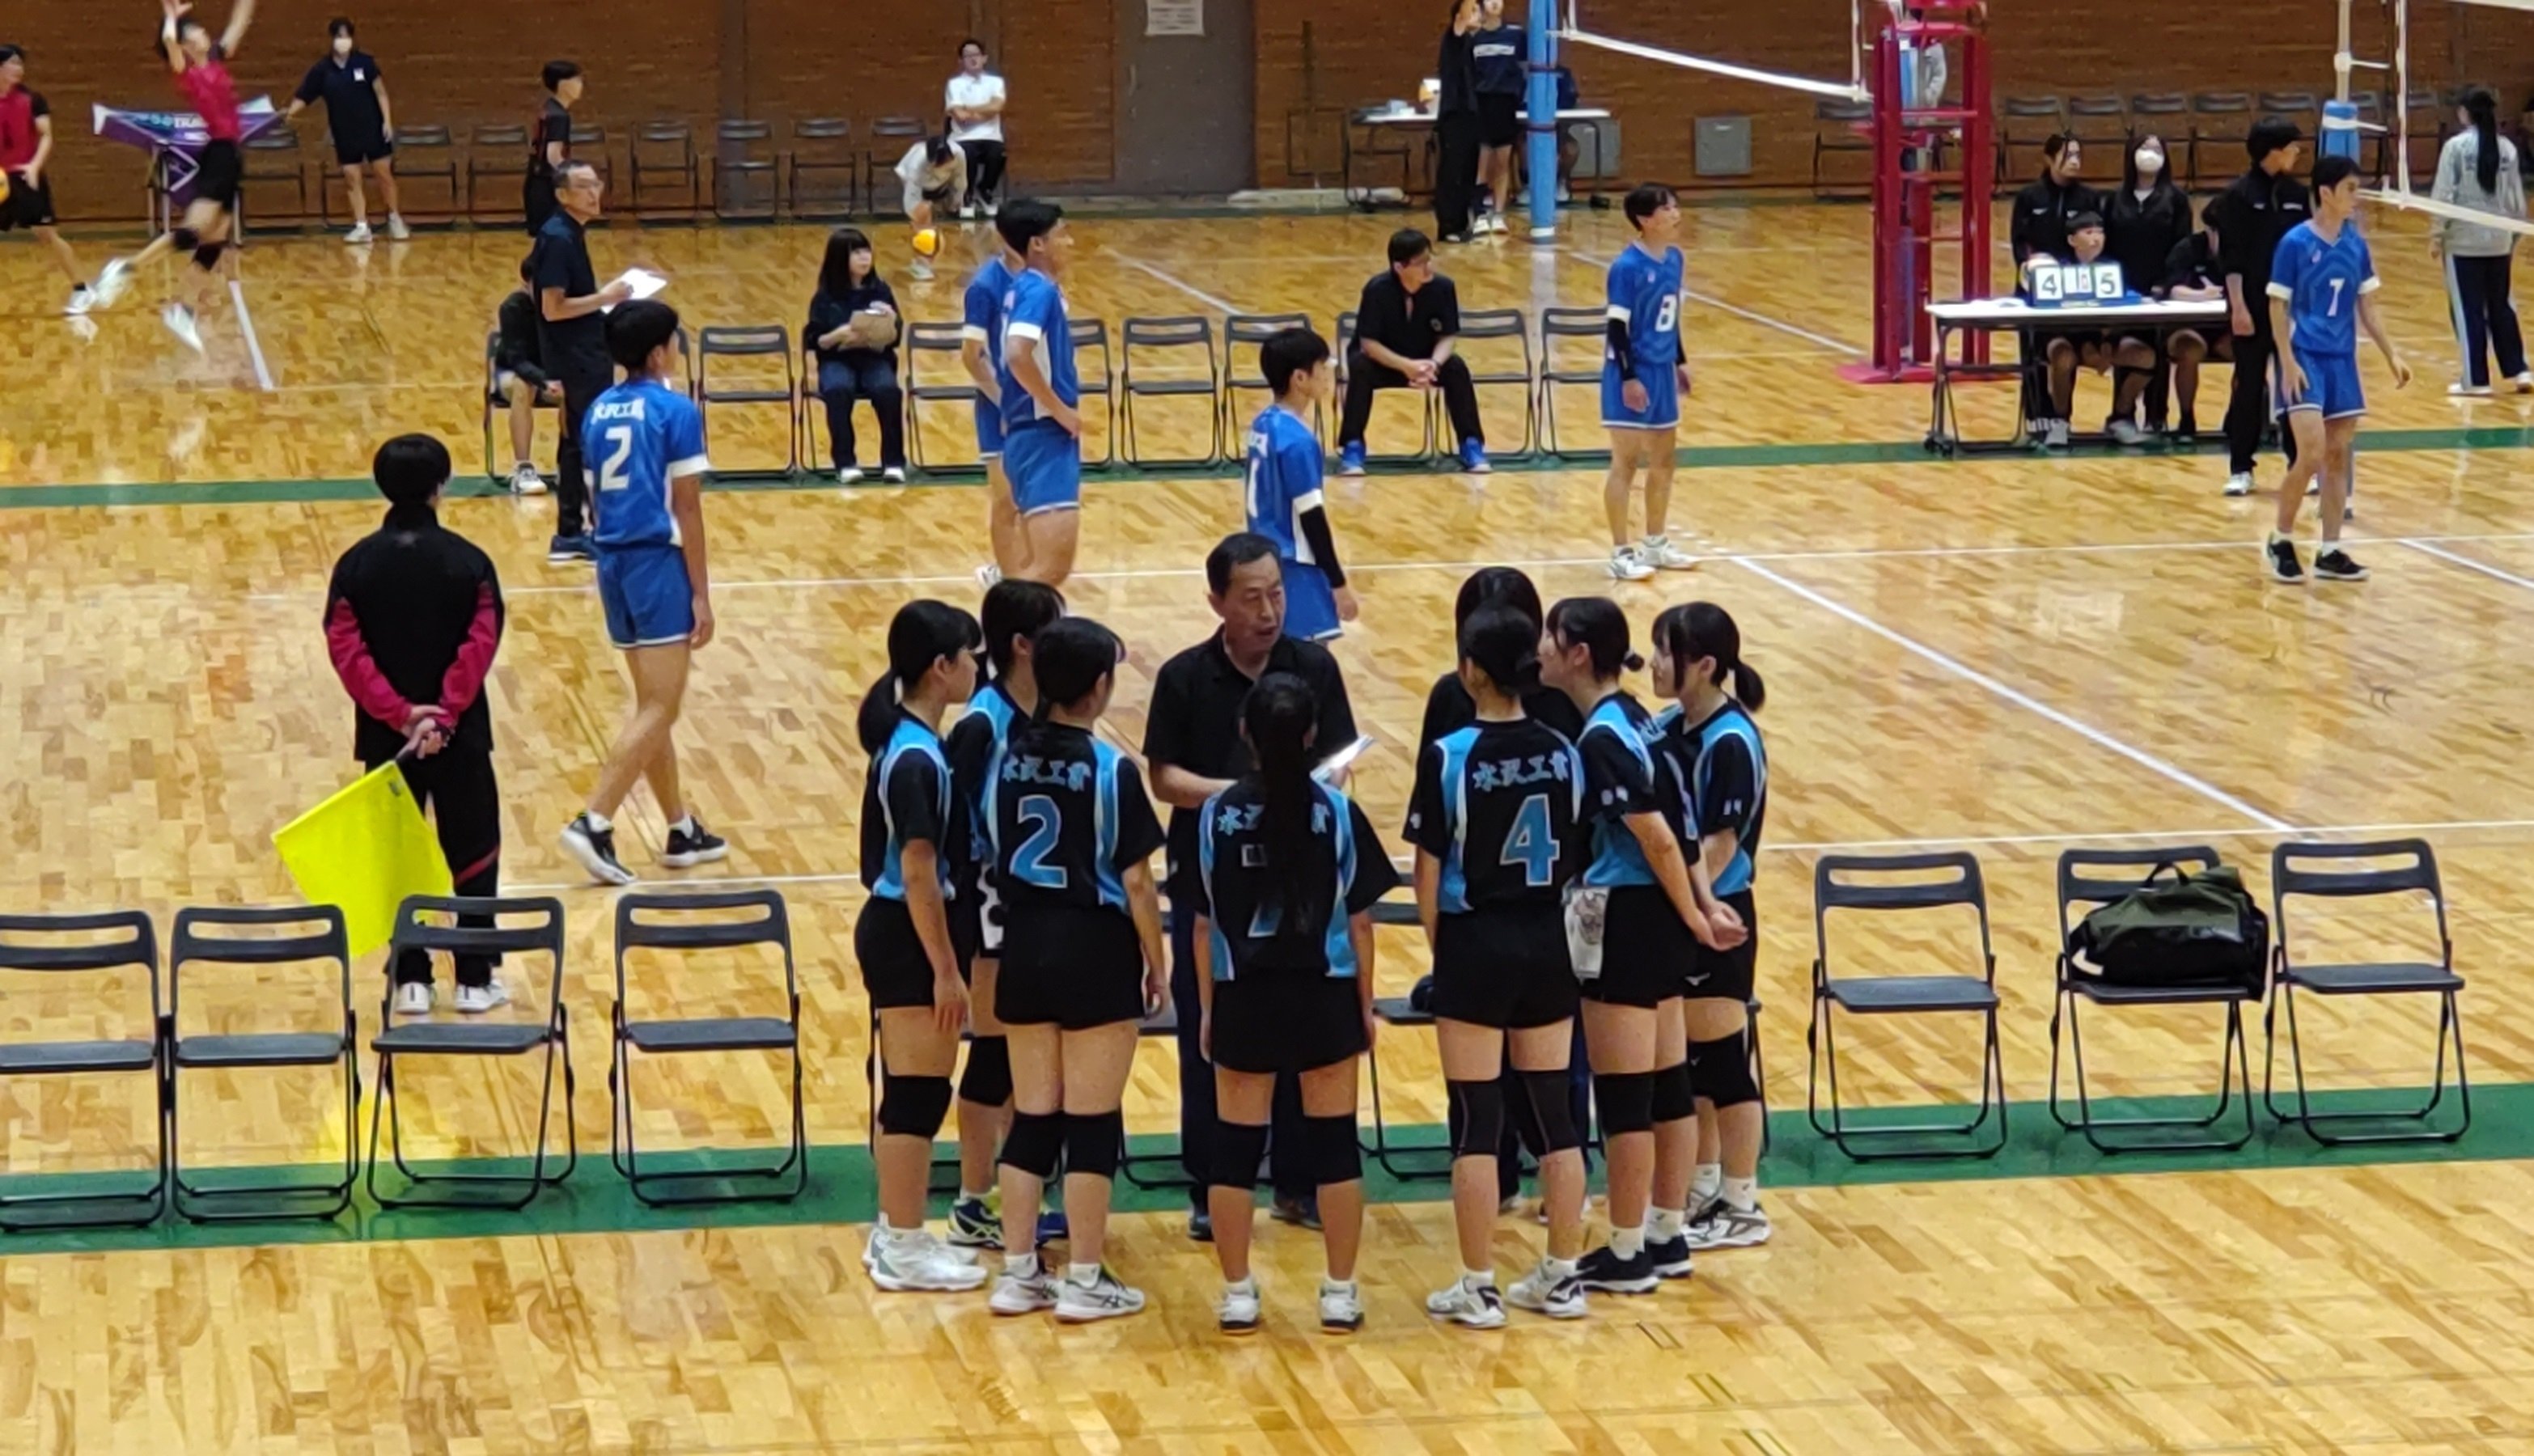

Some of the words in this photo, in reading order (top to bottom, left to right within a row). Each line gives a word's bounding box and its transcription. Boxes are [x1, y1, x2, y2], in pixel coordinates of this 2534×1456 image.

[2041, 273, 2057, 296] 4
[2100, 272, 2116, 294] 5
[2327, 277, 2345, 317] 7
[1655, 294, 1677, 332] 8
[600, 425, 632, 492] 2
[1009, 794, 1068, 888] 2
[1499, 793, 1561, 887] 4
